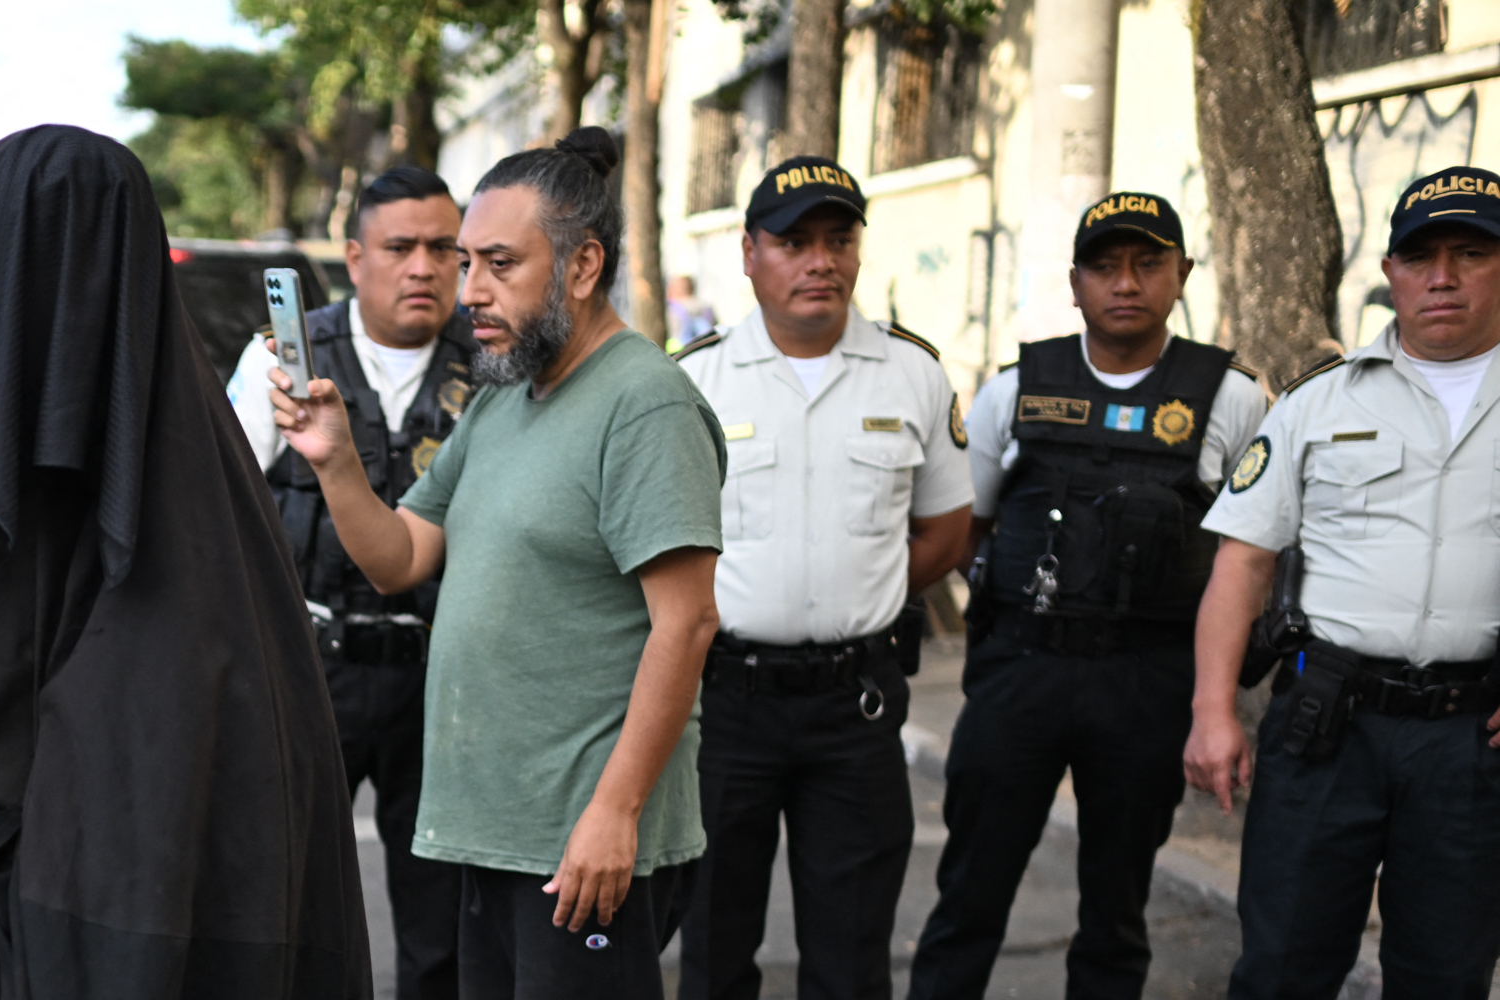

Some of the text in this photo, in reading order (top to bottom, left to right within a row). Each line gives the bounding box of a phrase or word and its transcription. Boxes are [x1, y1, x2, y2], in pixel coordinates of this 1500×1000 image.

[775, 165, 855, 194] POLICIA
[1404, 175, 1500, 210] POLICIA
[1085, 195, 1159, 228] POLICIA
